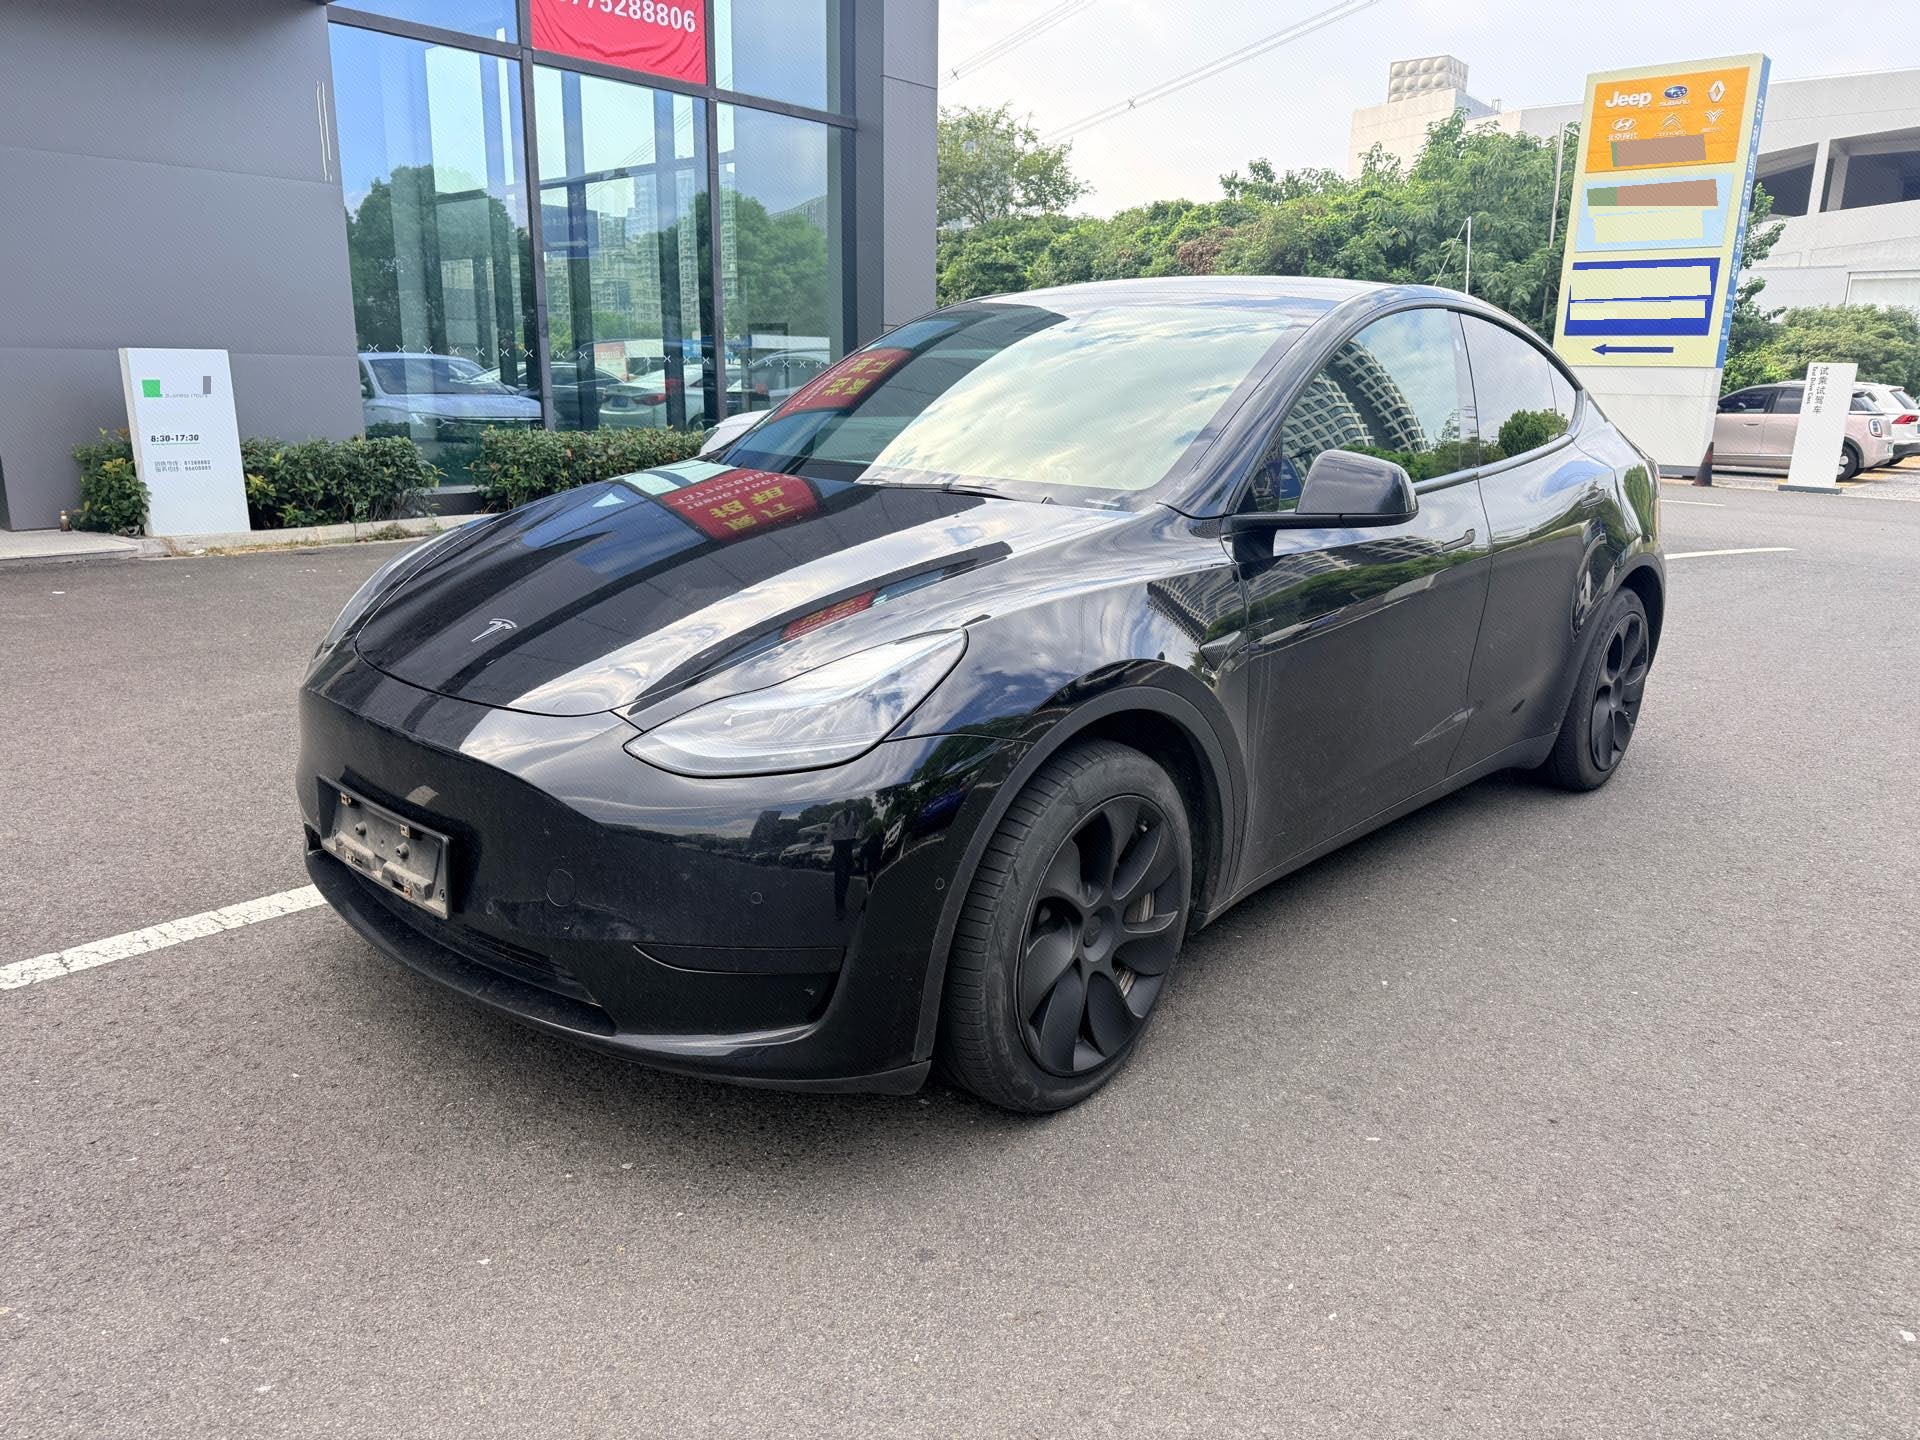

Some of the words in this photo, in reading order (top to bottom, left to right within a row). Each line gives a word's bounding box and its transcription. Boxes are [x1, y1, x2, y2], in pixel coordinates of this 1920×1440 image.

[560, 0, 696, 32] 5288806
[1605, 91, 1652, 107] Jeep
[151, 434, 199, 442] 8:30-17:30
